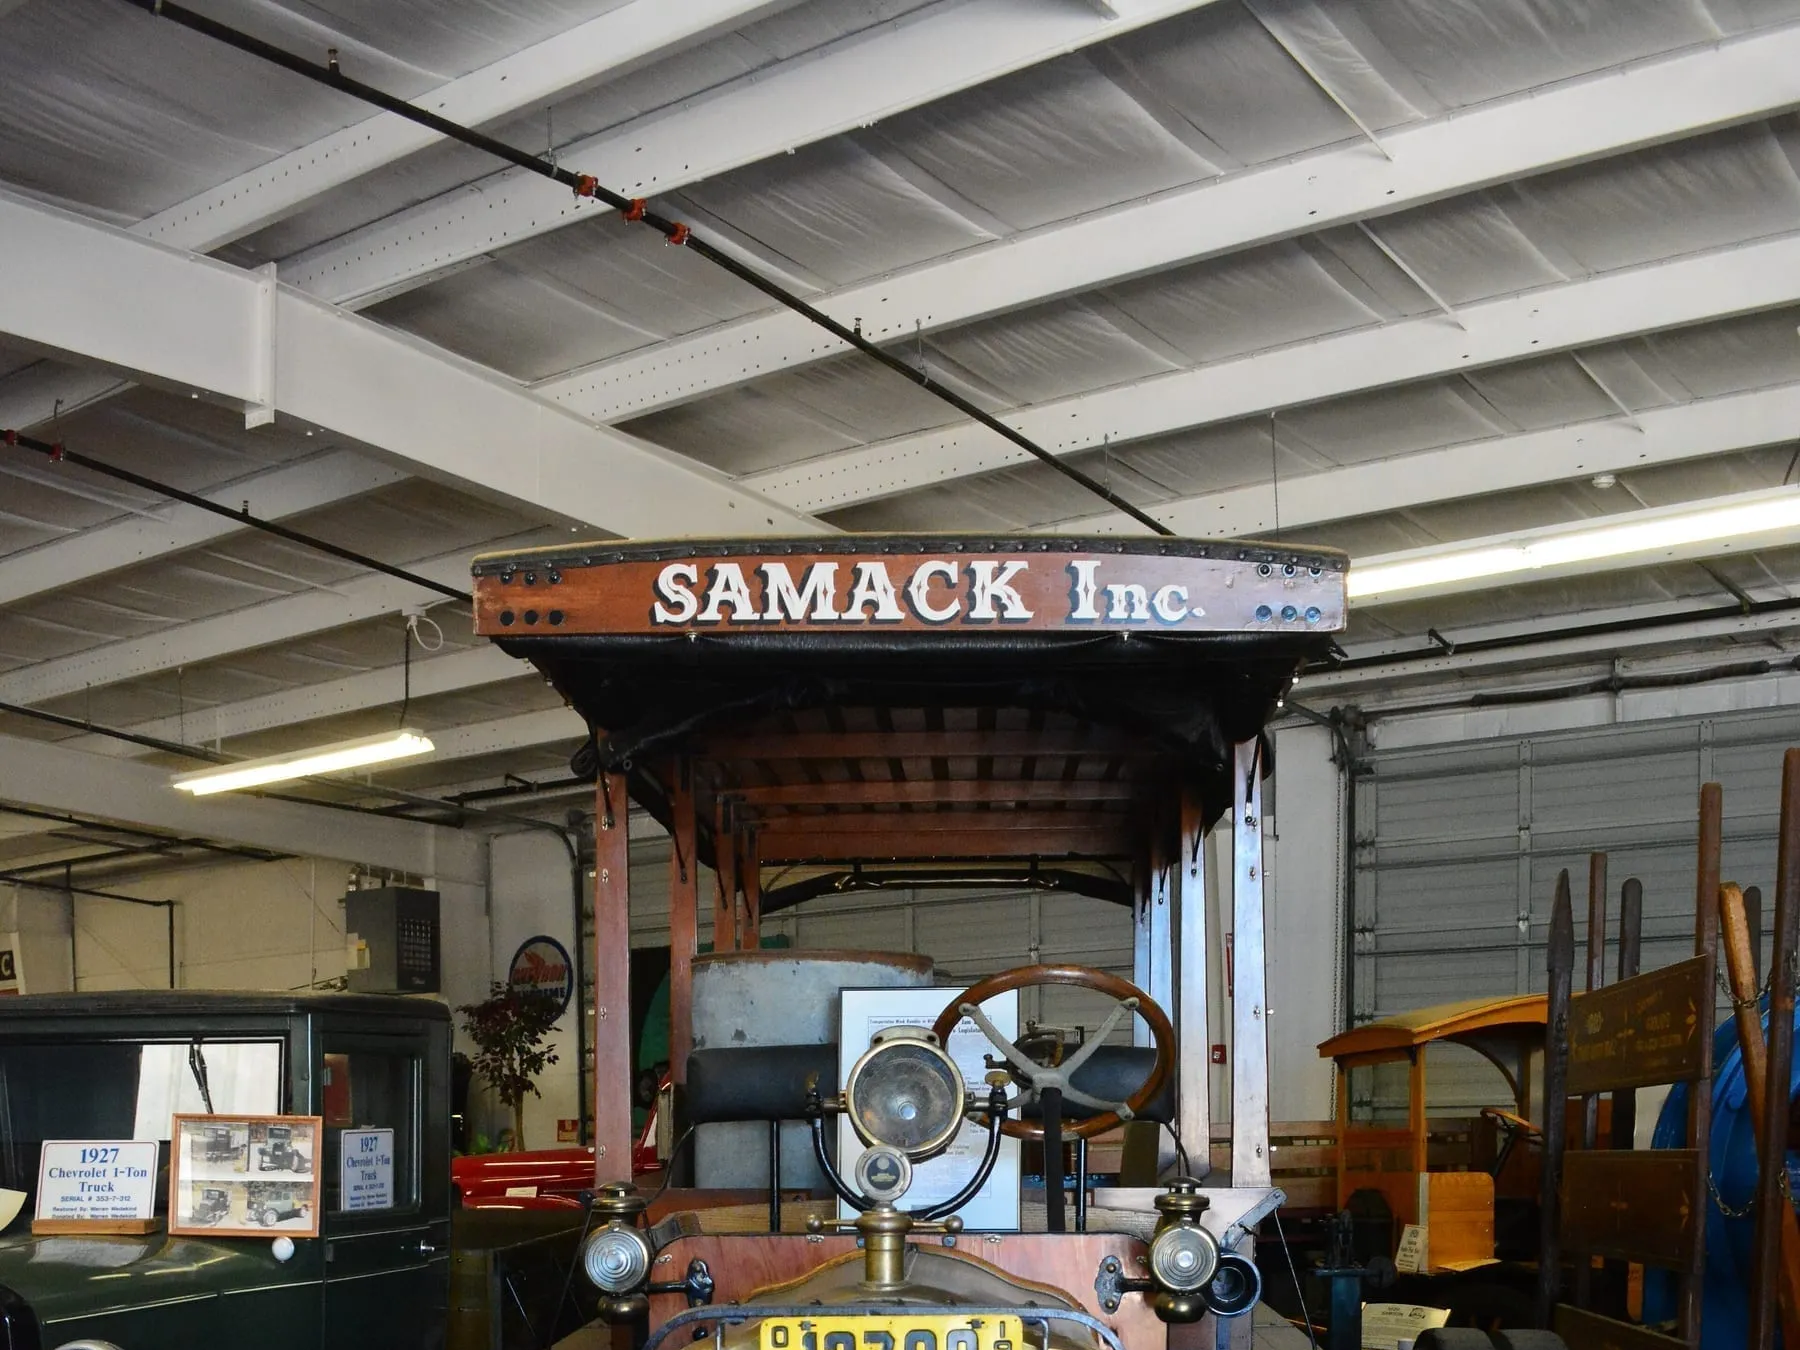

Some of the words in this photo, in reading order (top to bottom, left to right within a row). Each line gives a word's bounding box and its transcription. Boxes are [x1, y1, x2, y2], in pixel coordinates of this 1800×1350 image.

[653, 560, 1035, 624] SAMACK
[1067, 560, 1206, 623] Inc.
[360, 1136, 378, 1153] 1927
[80, 1148, 120, 1164] 1927
[48, 1167, 107, 1178] Chevrolet
[113, 1166, 148, 1178] 1-Ton
[79, 1181, 115, 1193] Truck
